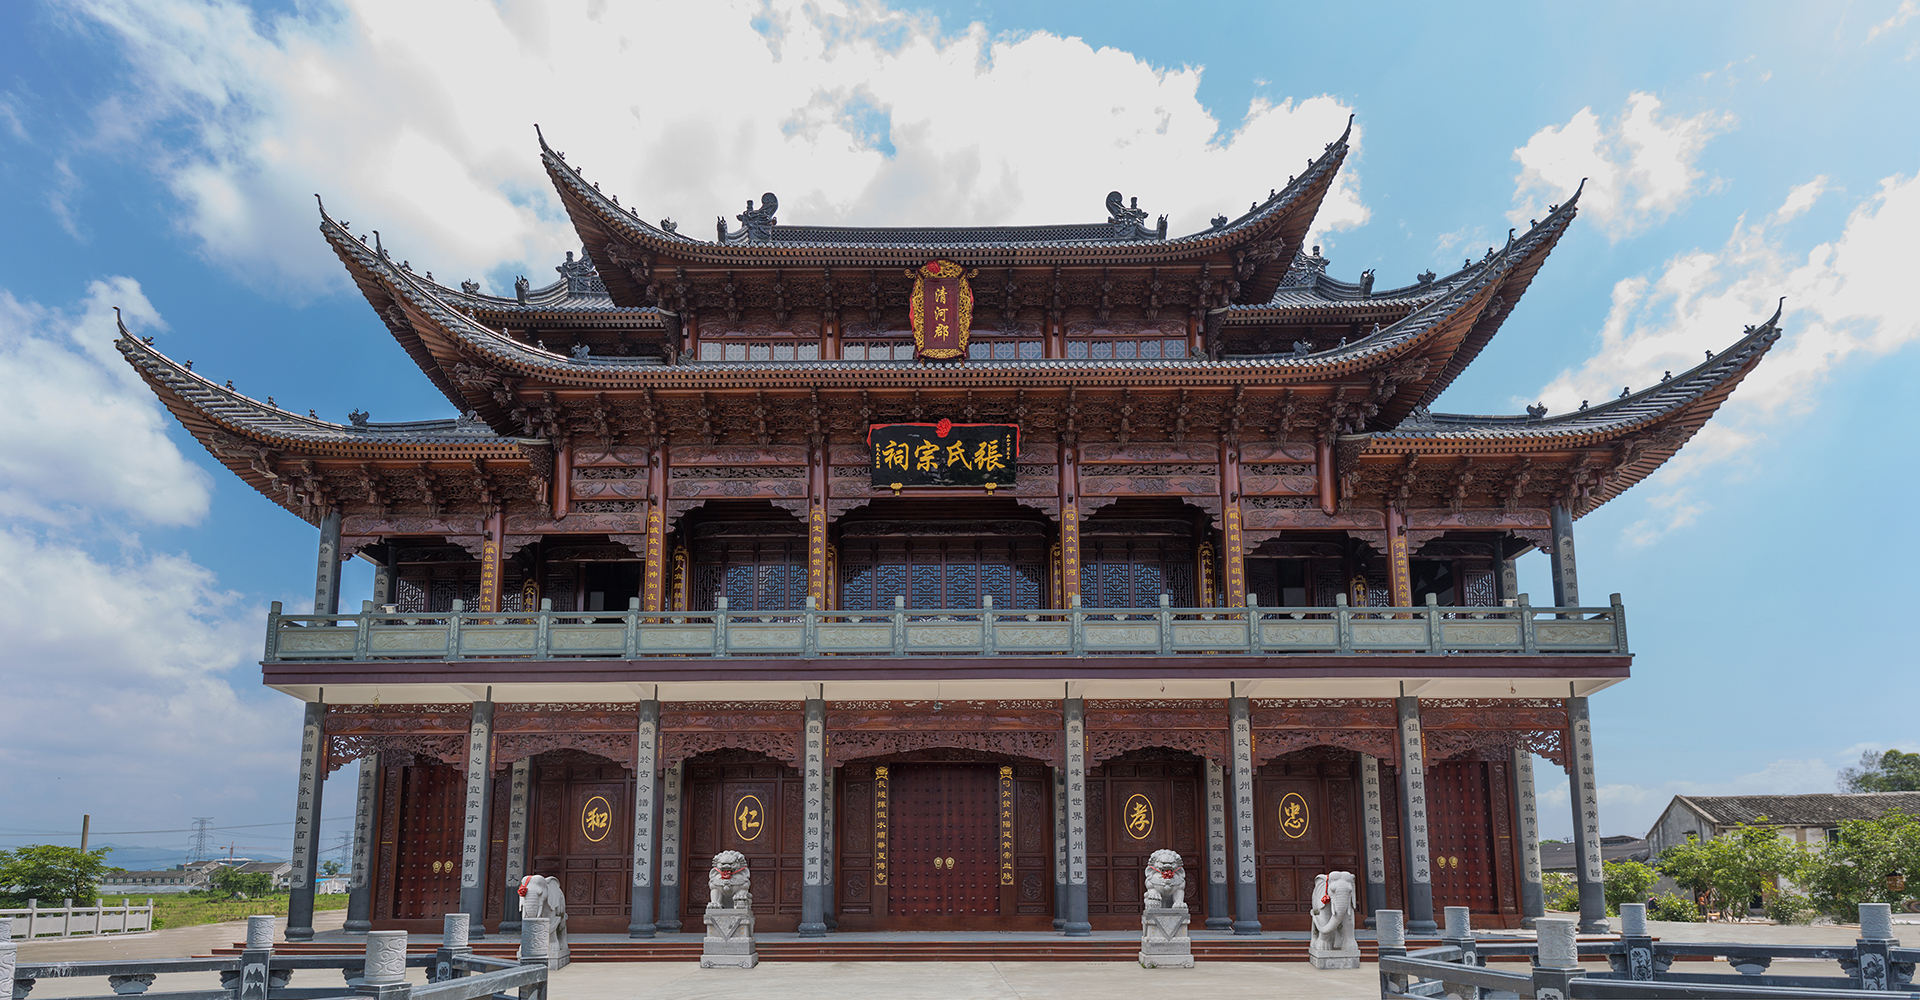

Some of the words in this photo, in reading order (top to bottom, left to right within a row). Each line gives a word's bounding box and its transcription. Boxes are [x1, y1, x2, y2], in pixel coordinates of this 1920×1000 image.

[933, 285, 950, 342] 清河郡
[881, 438, 1006, 472] 張氏宗祠
[585, 807, 609, 832] 和
[738, 805, 760, 831] 仁
[1129, 801, 1150, 831] 孝
[1283, 801, 1305, 830] 忠
